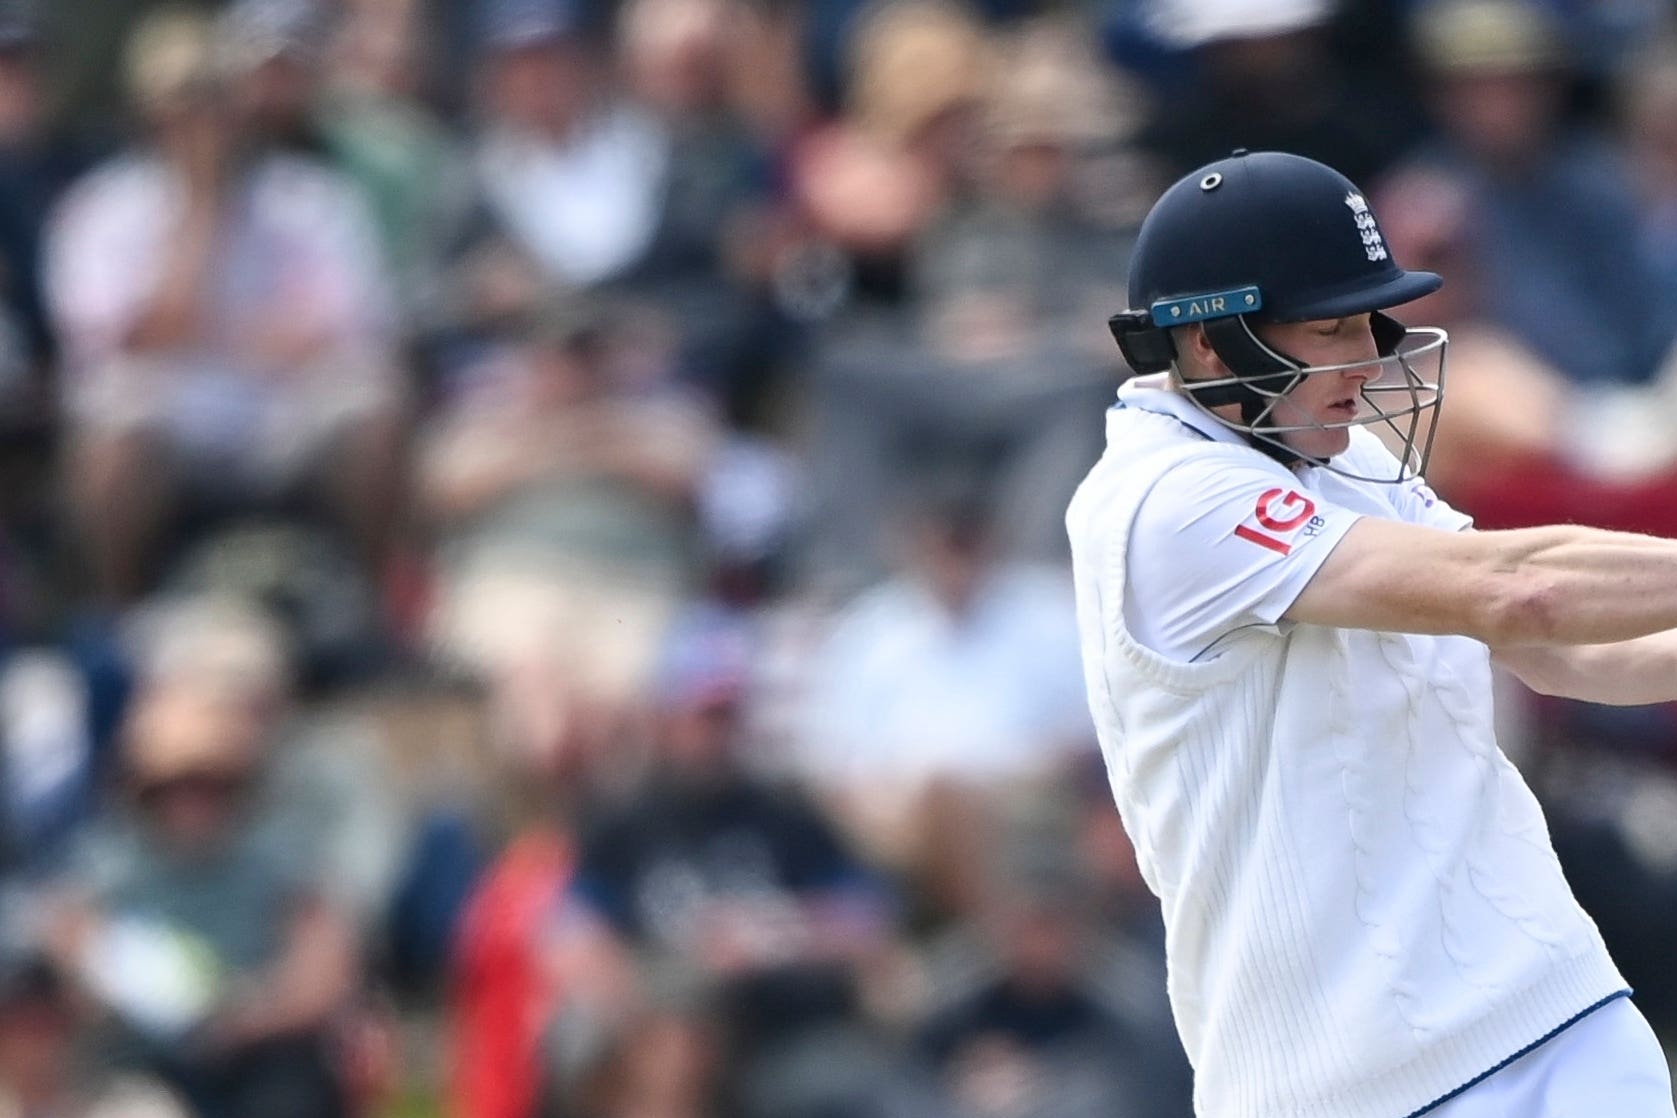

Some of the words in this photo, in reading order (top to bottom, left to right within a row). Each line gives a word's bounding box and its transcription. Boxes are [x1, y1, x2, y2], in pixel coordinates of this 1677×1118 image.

[1189, 297, 1225, 317] AIR
[1234, 488, 1315, 556] IG
[1303, 515, 1325, 538] HB
